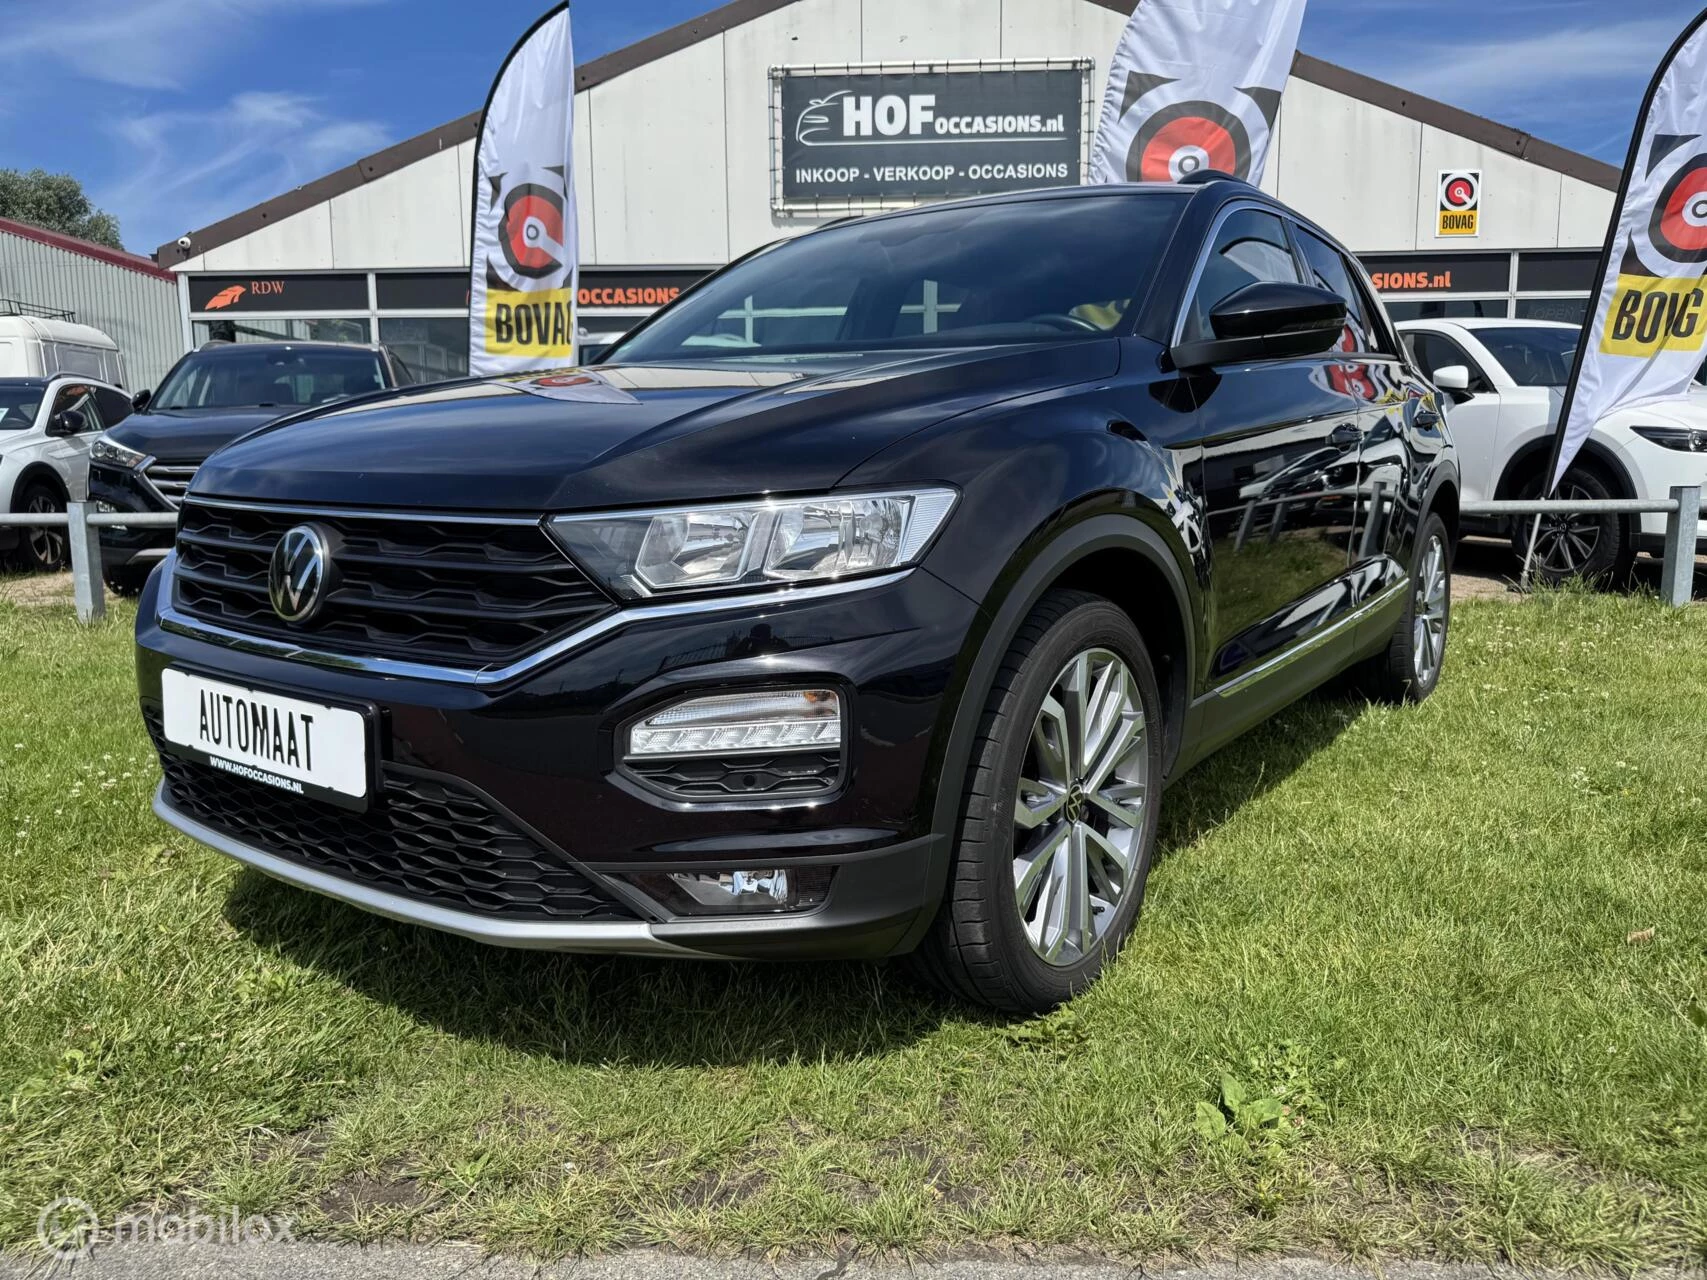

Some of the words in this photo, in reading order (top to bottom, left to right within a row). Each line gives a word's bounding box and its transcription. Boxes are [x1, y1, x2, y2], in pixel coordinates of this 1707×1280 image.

[796, 168, 859, 183] INKOOP
[873, 166, 955, 182] VERKOOP
[968, 163, 1068, 180] OCCASIONS
[1442, 214, 1474, 230] BOVAG
[251, 281, 285, 295] RDW
[578, 287, 680, 305] OCCASIONS
[200, 689, 314, 771] AUTOMAAT
[209, 755, 304, 795] WWW.HOFOCCASIONS.NL
